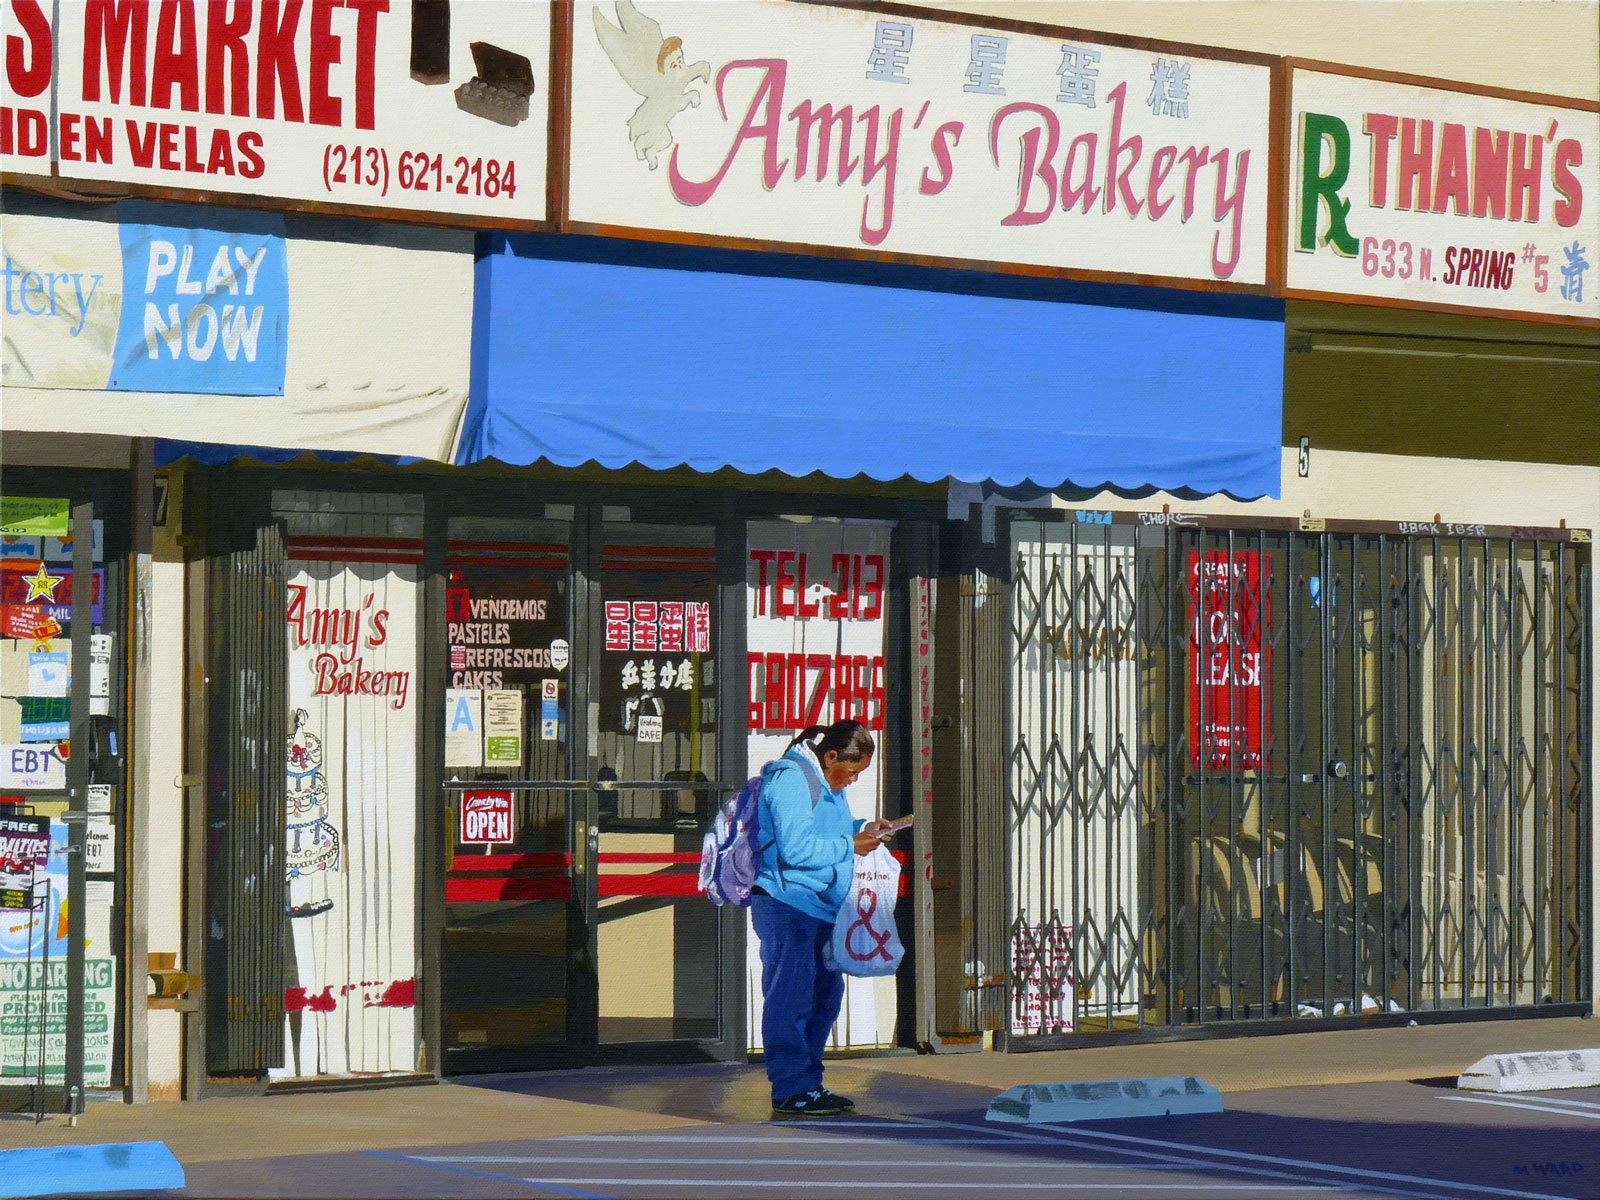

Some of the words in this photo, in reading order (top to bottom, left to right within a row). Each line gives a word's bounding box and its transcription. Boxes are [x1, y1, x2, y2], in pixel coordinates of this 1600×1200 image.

[82, 0, 390, 131] MARKET
[60, 112, 114, 164] EN
[125, 119, 266, 179] VELAS
[323, 144, 390, 197] (213)
[398, 150, 516, 199] 621-2184
[668, 59, 964, 245] Amy's
[989, 81, 1251, 279] Bakery
[1362, 112, 1583, 227] THANH'S
[144, 240, 267, 296] PLAY
[1362, 236, 1413, 279] 633
[1419, 248, 1437, 282] N.
[1443, 246, 1516, 290] SPRING
[1522, 243, 1550, 293] #5
[0, 256, 104, 337] tery
[144, 302, 264, 362] NOW
[1300, 437, 1309, 476] 5
[155, 477, 169, 524] 7
[287, 585, 390, 664] Amy's
[469, 599, 547, 620] VENDEMOS
[448, 623, 511, 644] PASTELES
[466, 648, 551, 668] REFRESCOS
[315, 652, 410, 709] Bakery
[452, 671, 503, 690] CAKES
[451, 697, 475, 732] A
[639, 730, 661, 740] CAFE
[12, 749, 50, 773] EBT
[0, 820, 39, 832] FREE
[466, 811, 508, 839] OPEN
[87, 844, 102, 856] EBT
[0, 963, 27, 989] NO
[30, 961, 109, 987] PARNG
[3, 1002, 106, 1014] PROHIBED
